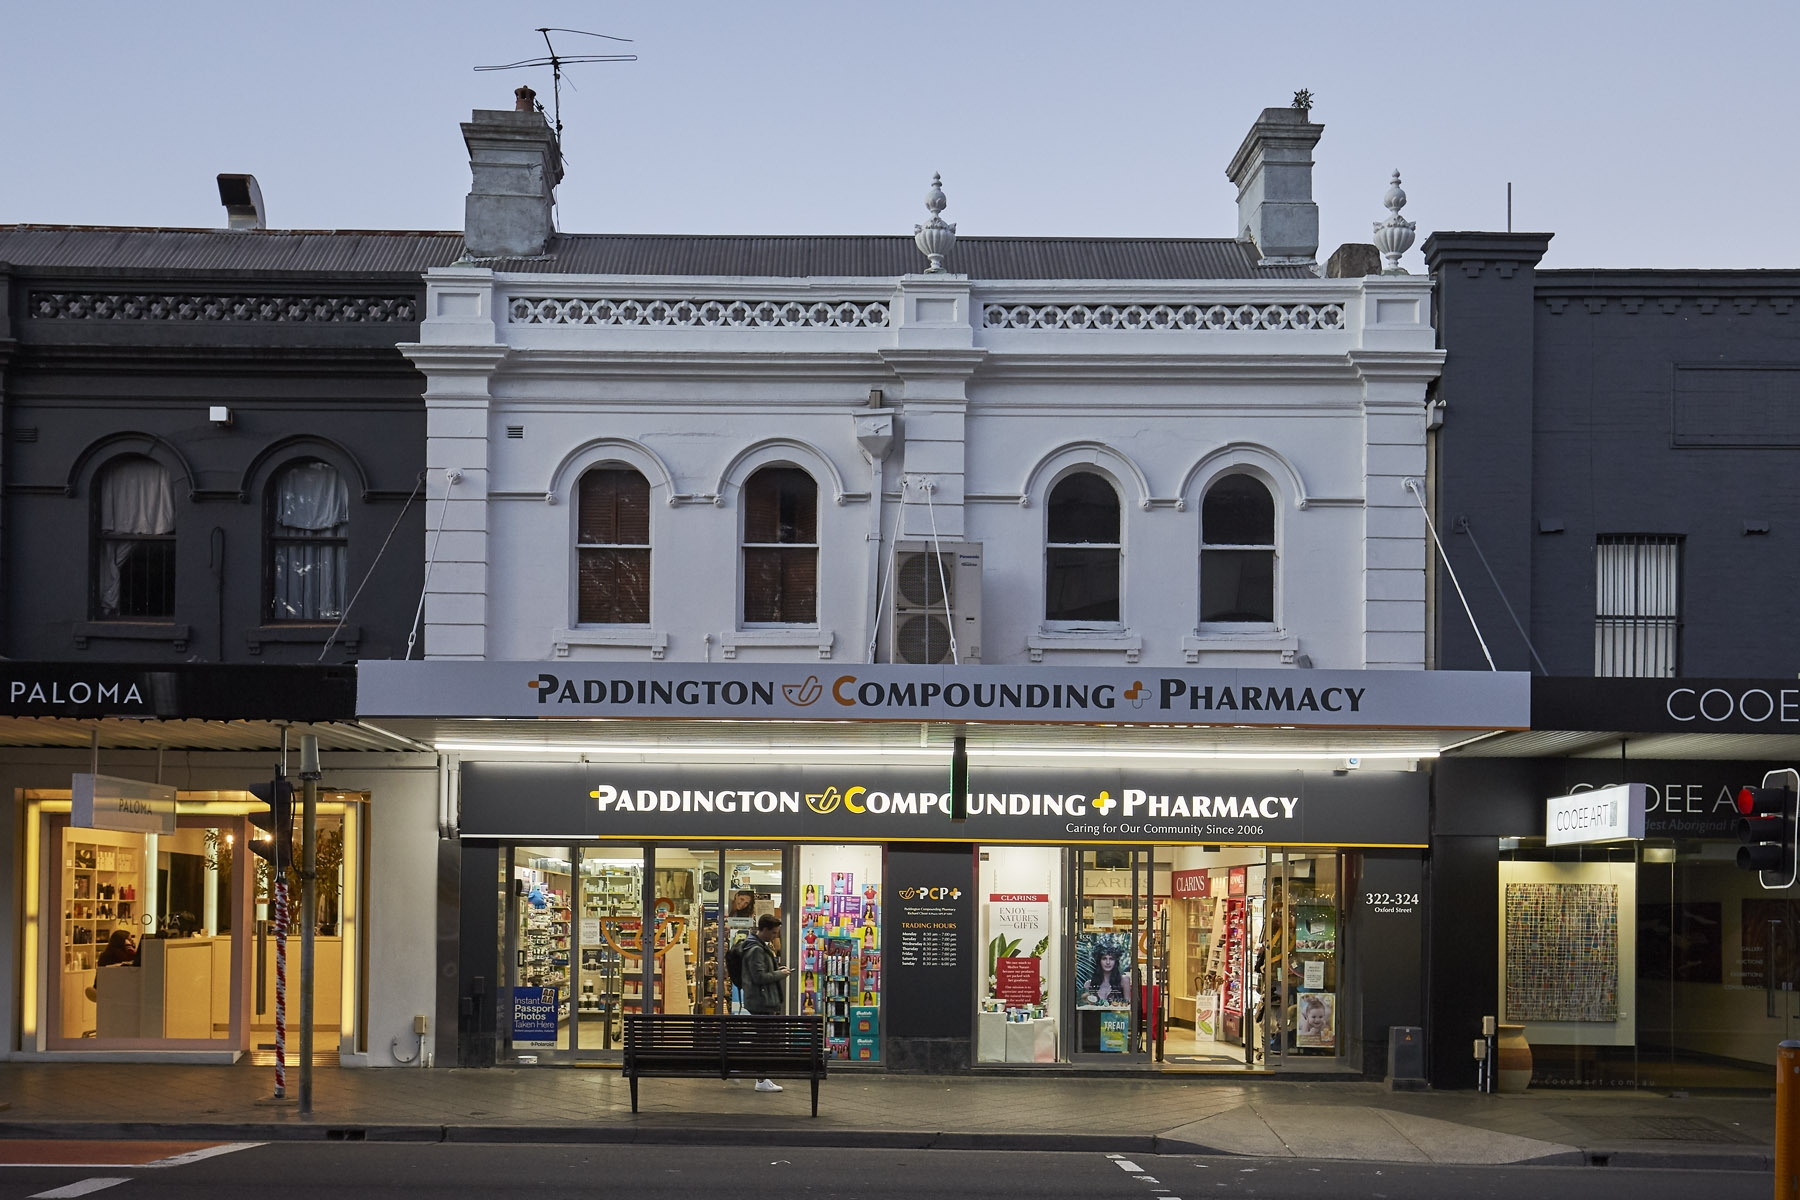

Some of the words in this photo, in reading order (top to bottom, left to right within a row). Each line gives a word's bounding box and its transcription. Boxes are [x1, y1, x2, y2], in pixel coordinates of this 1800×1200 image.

[10, 681, 144, 704] PALOMA
[529, 674, 774, 705] PADDINGTON
[832, 675, 1115, 709] COMPOUNDING
[1159, 678, 1366, 712] PHARMACY
[119, 798, 153, 816] PALOMA
[590, 784, 800, 813] PADDINGTON
[1122, 789, 1299, 819] PHARMACY
[1556, 807, 1589, 832] COOEE
[1590, 804, 1609, 827] ART
[1065, 822, 1100, 835] Caring
[1103, 822, 1117, 834] for
[1119, 823, 1141, 834] Our
[1143, 823, 1203, 836] Community
[1206, 824, 1234, 835] Since
[1237, 825, 1264, 835] 2006
[1668, 818, 1727, 833] Aboriginal
[1176, 876, 1205, 892] CLARINS
[1365, 892, 1420, 905] 322-324
[1000, 907, 1025, 915] ENJOY
[514, 996, 540, 1005] Instant
[514, 1004, 555, 1013] Passport
[514, 1012, 546, 1020] Photos
[514, 1020, 535, 1028] Taken
[536, 1020, 555, 1028] Here
